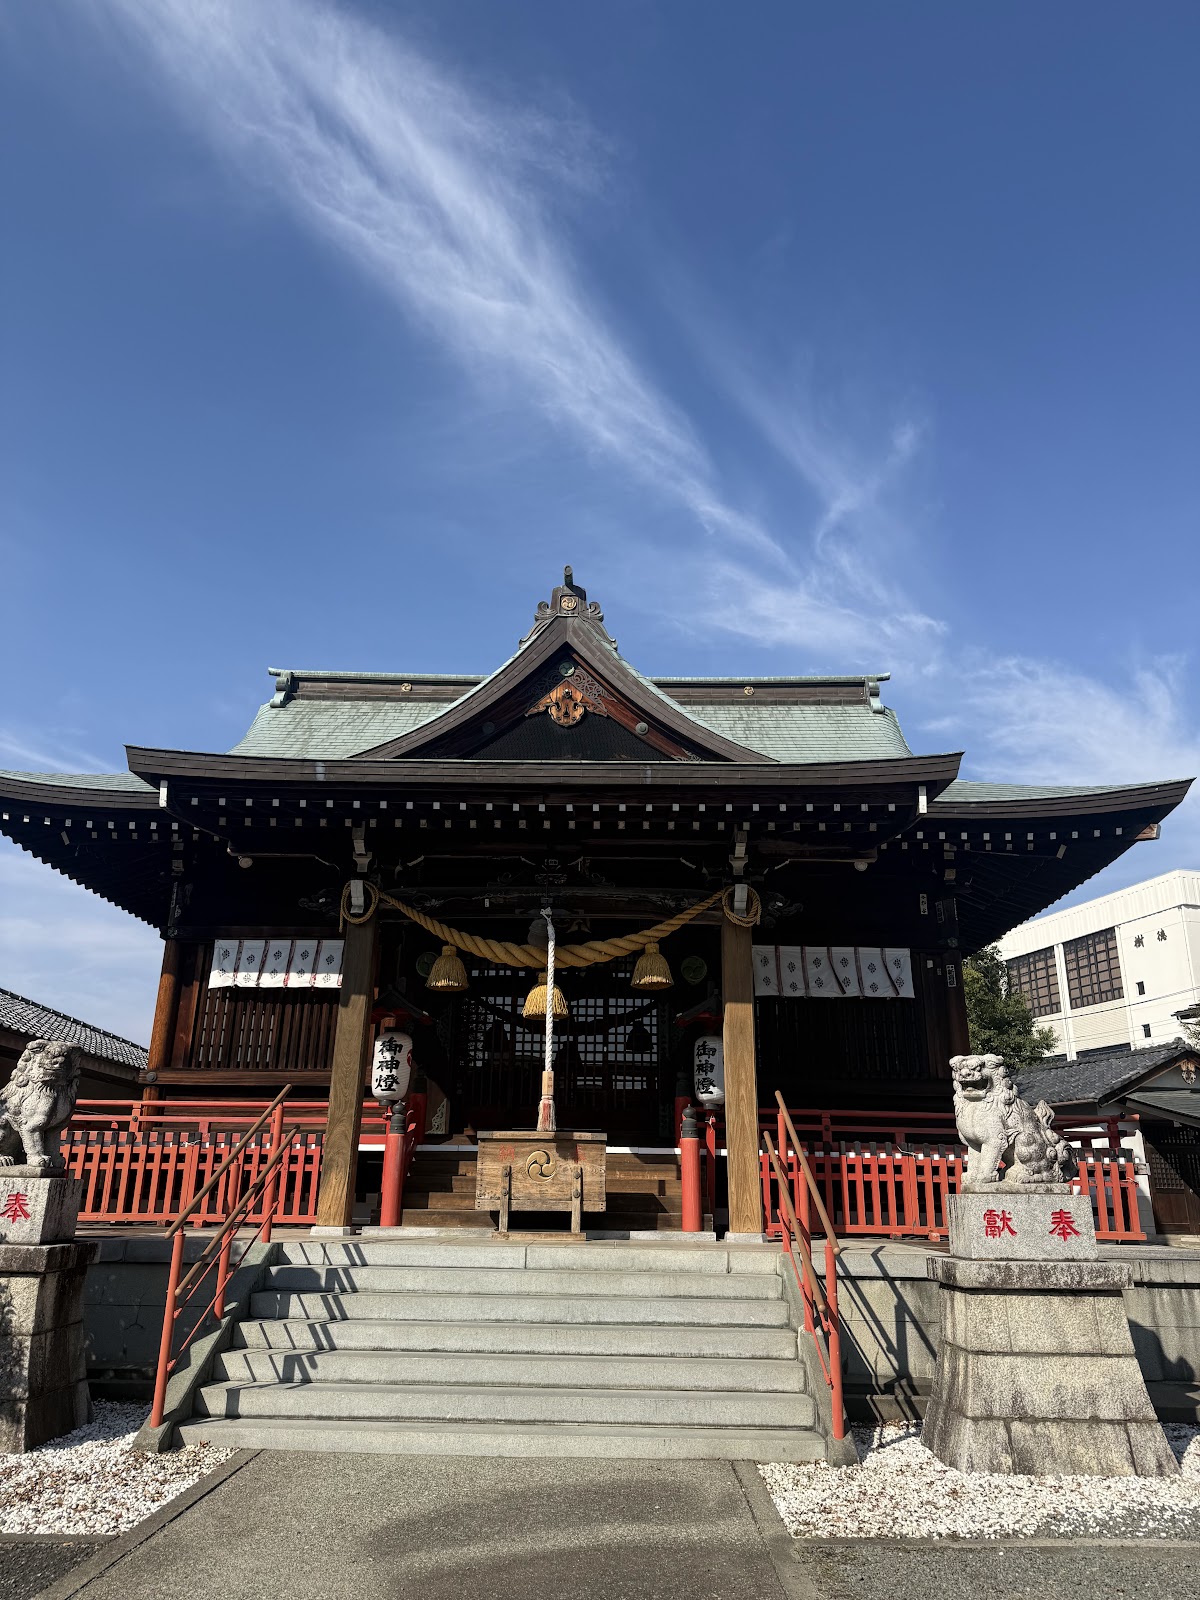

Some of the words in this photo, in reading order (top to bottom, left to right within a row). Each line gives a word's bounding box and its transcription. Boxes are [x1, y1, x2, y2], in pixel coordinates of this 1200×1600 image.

[375, 1036, 403, 1092] 御神燈
[695, 1040, 718, 1094] 御神燈
[0, 1192, 31, 1224] 奉
